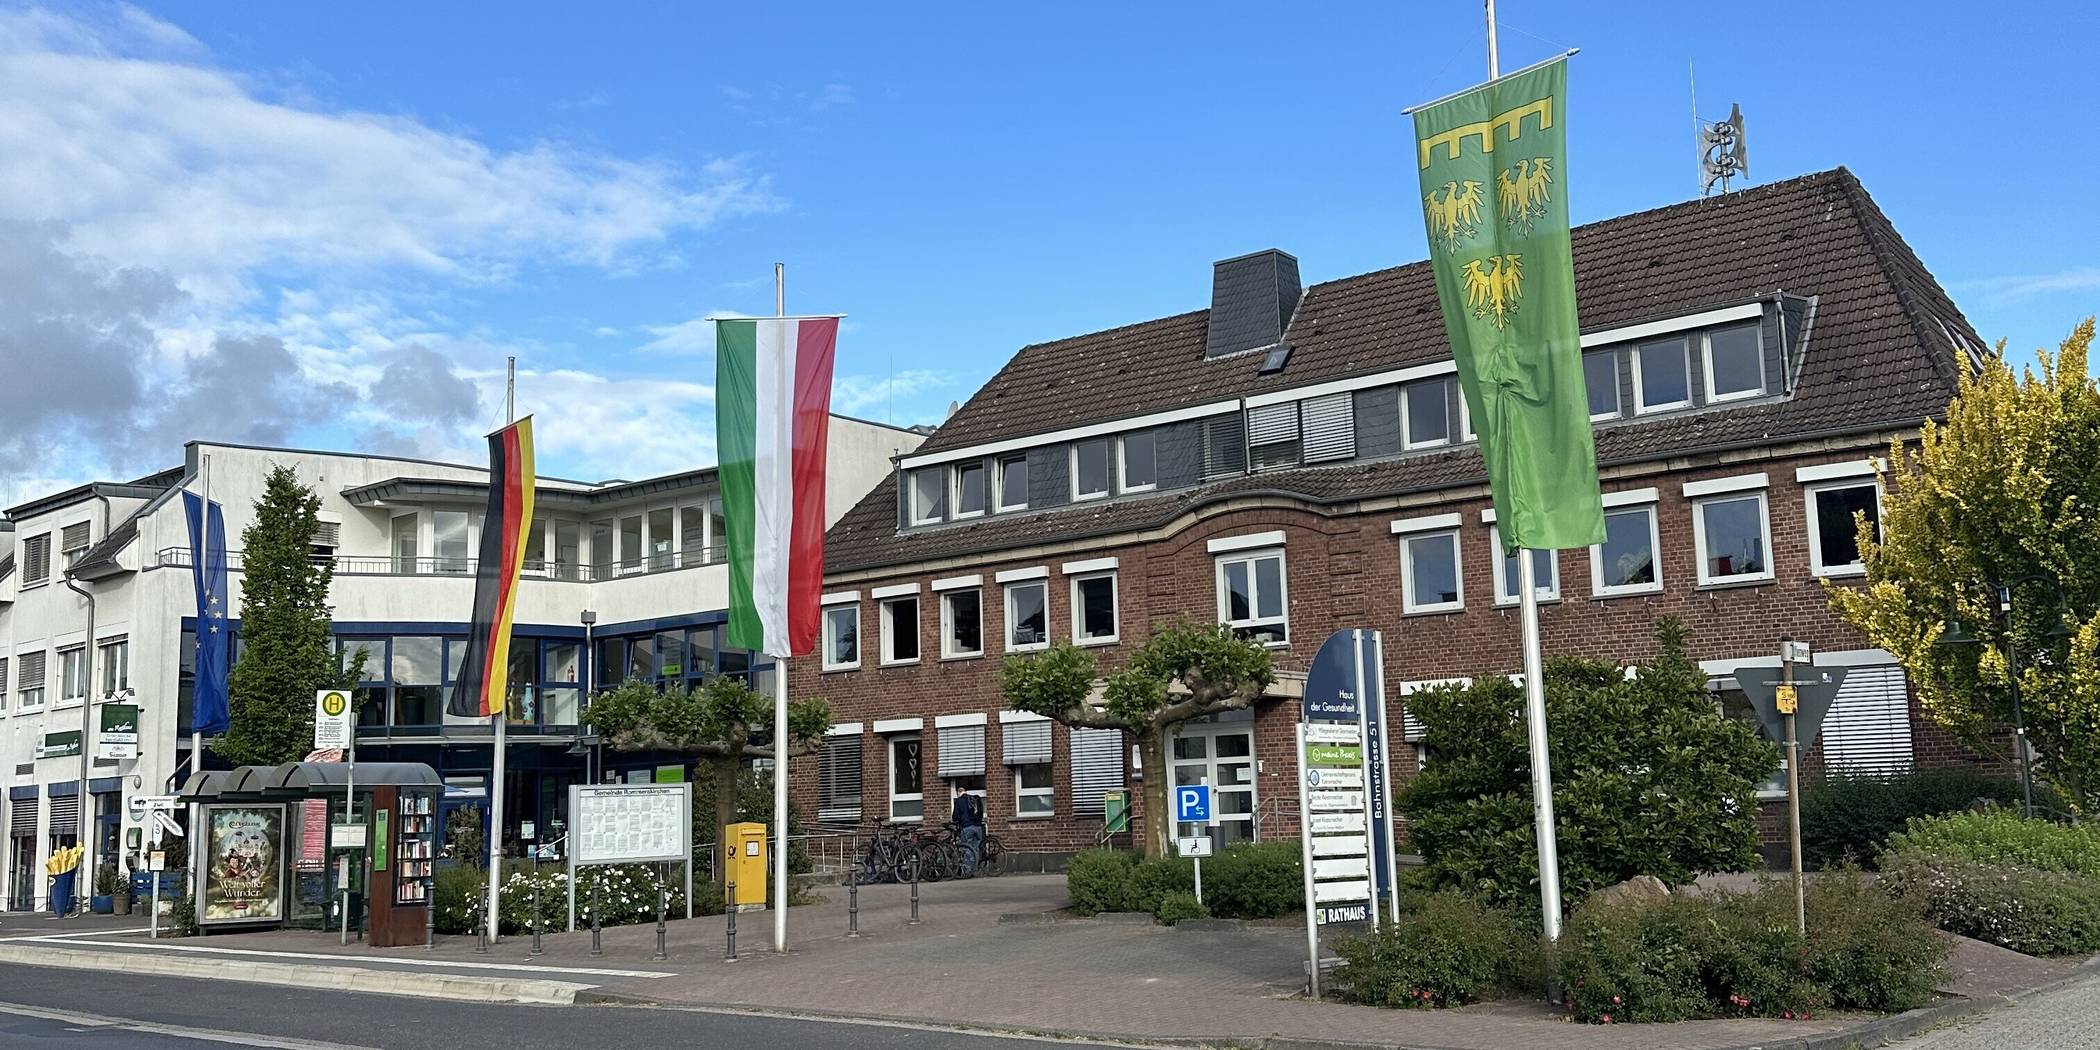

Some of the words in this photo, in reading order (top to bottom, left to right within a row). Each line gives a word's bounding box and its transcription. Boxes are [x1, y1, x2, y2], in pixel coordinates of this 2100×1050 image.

[1339, 689, 1354, 699] Haus
[329, 697, 340, 711] H
[1310, 701, 1321, 711] der
[1322, 702, 1355, 712] Gesundheit
[1369, 721, 1377, 736] 51
[1372, 740, 1383, 819] Bahnstrasse
[1181, 790, 1200, 817] P
[223, 889, 260, 898] Wunder
[1328, 905, 1366, 922] RATHAUS
